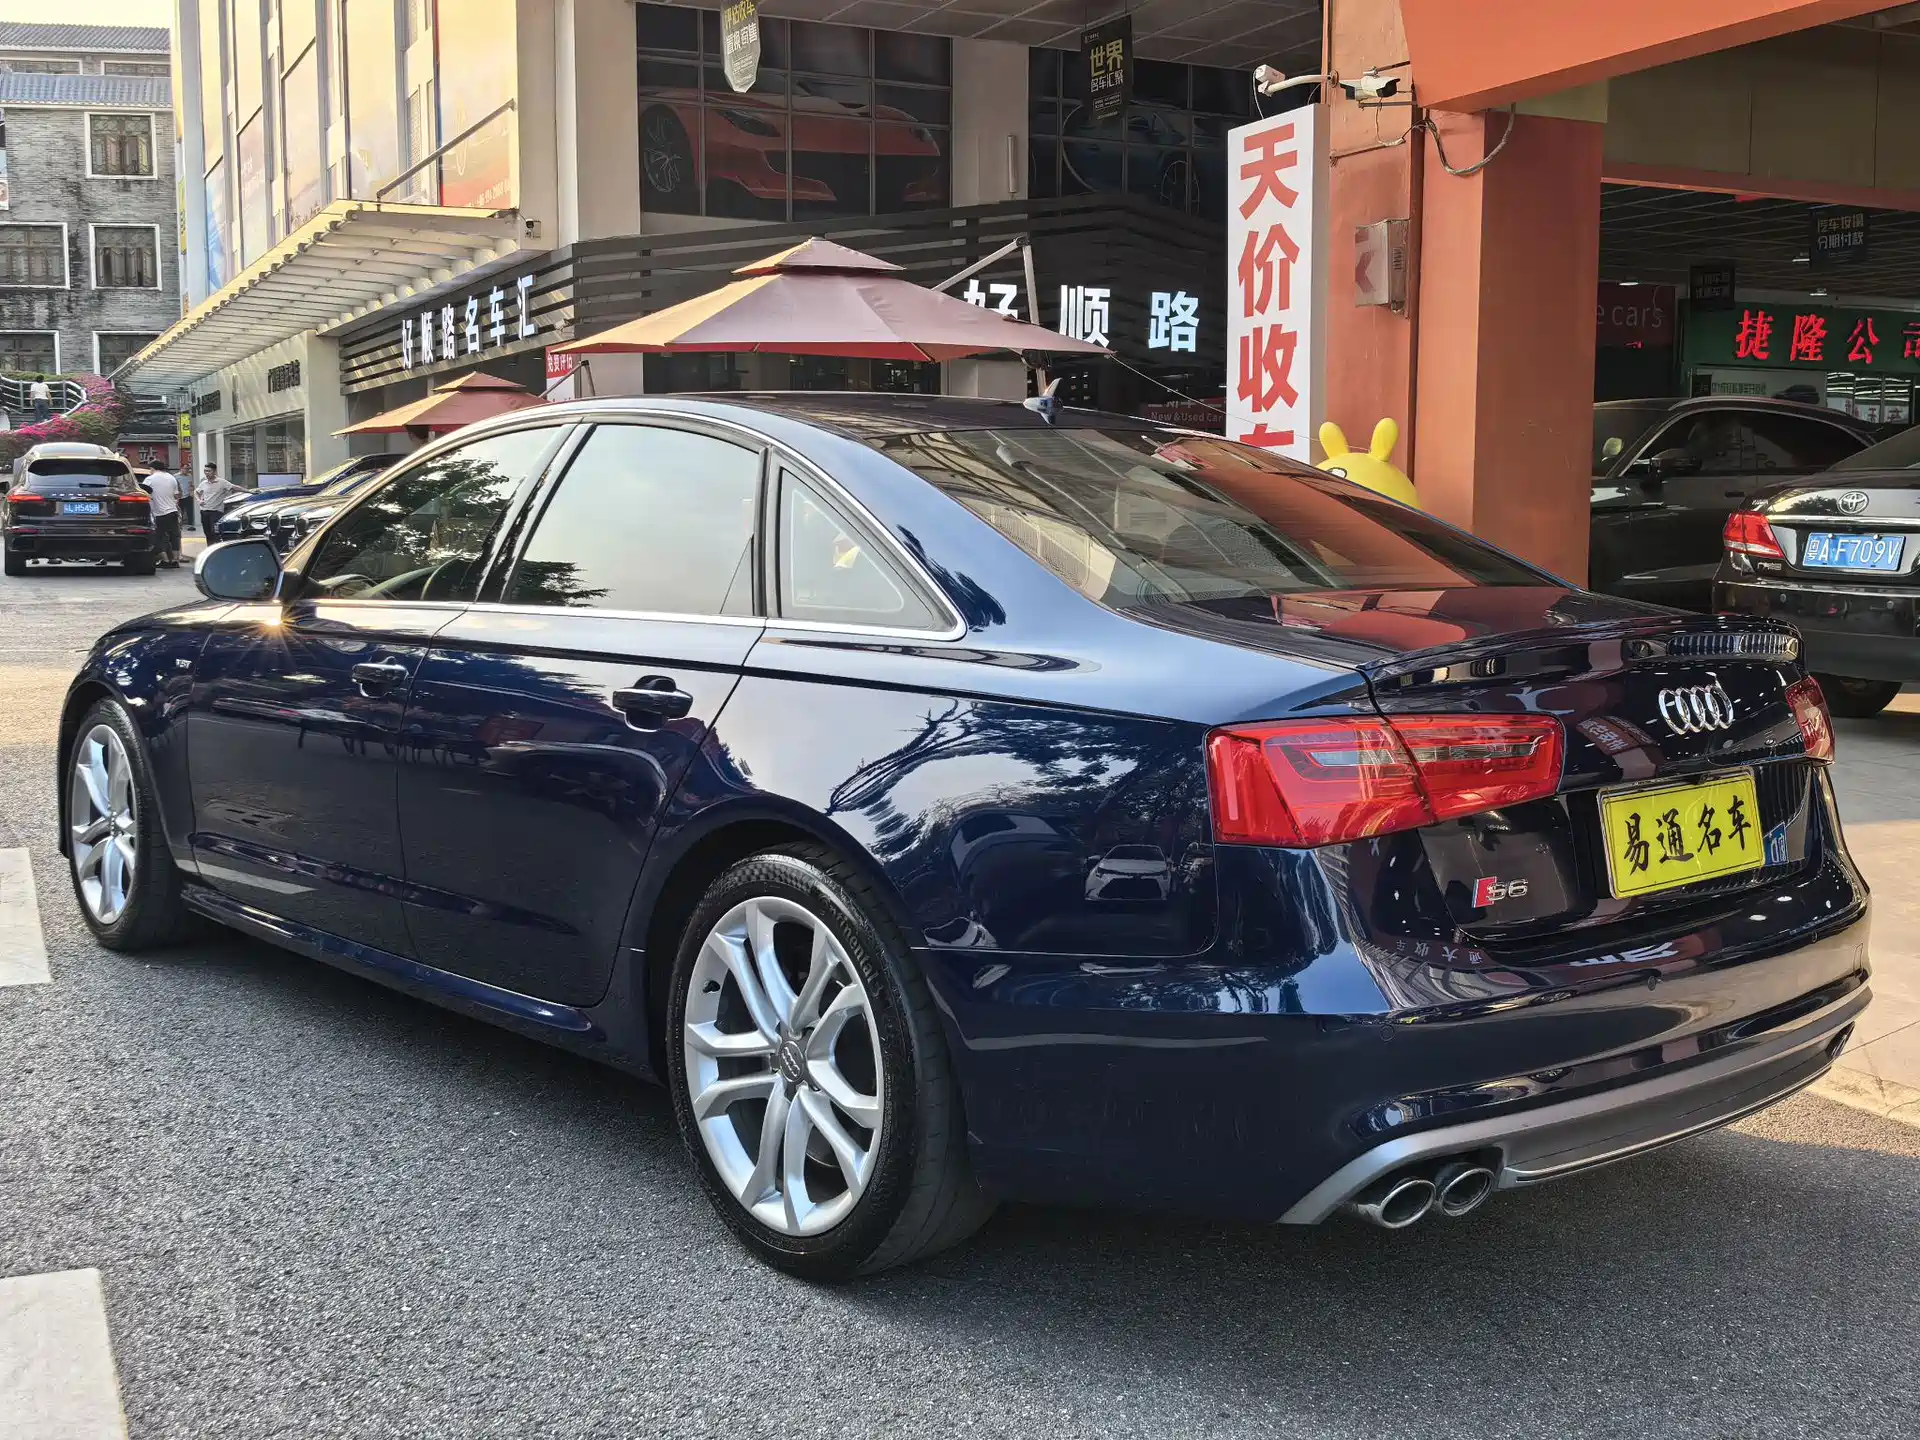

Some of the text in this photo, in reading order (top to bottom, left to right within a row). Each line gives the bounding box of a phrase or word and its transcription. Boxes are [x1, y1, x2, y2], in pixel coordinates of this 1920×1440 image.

[1090, 38, 1124, 77] 世界
[1090, 69, 1124, 92] 名车汇聚
[1238, 122, 1300, 448] 天价收
[402, 274, 539, 370] 好顺路名车汇
[1612, 305, 1664, 328] cars
[1623, 795, 1751, 876] 易通名车
[1486, 878, 1529, 901] S6
